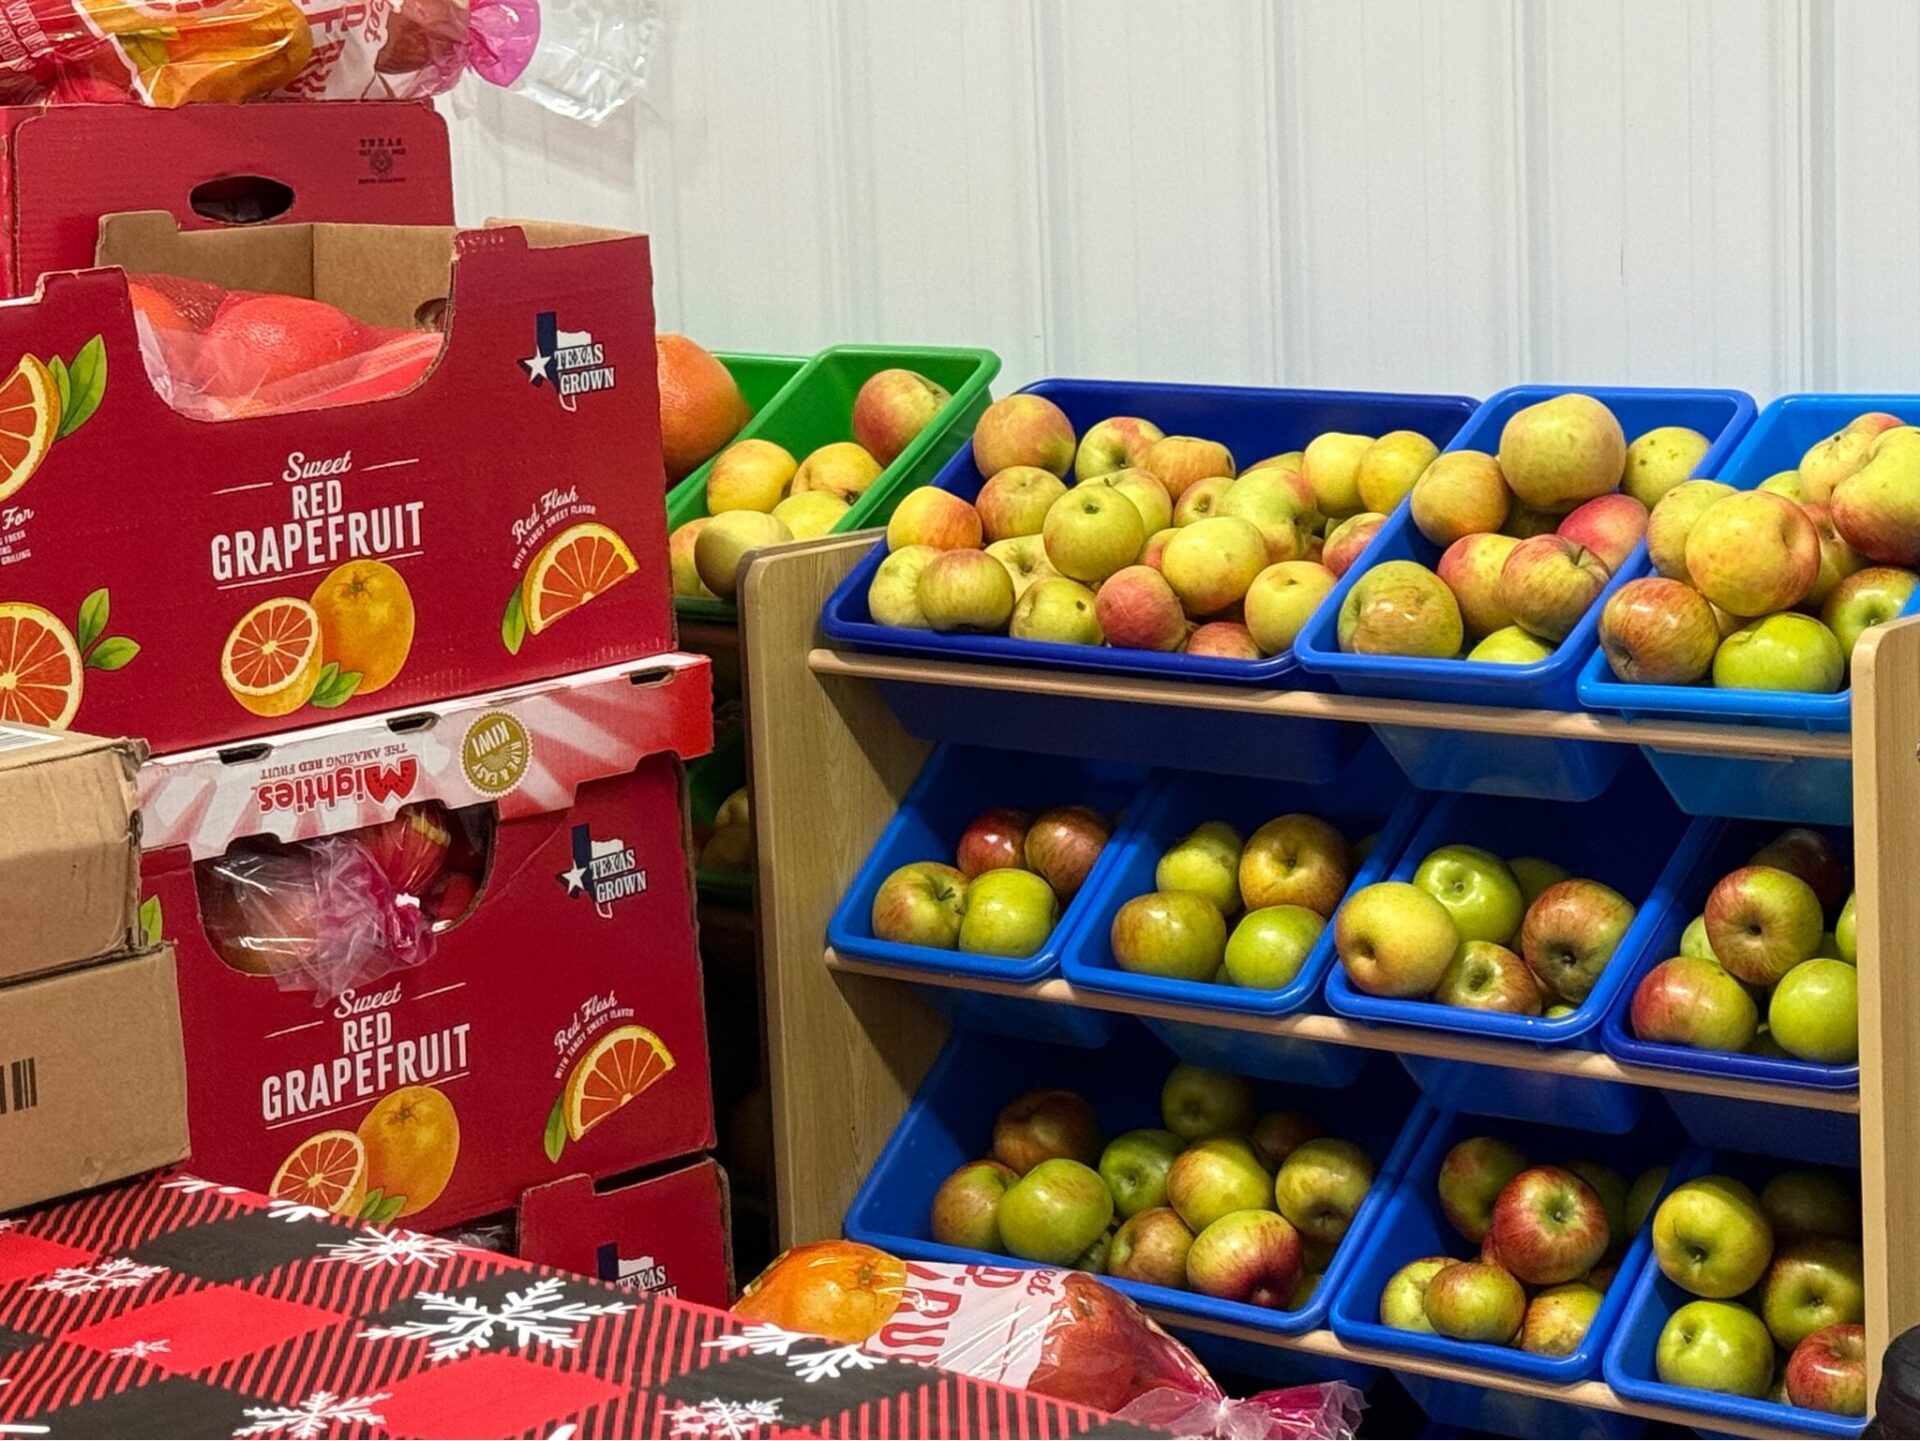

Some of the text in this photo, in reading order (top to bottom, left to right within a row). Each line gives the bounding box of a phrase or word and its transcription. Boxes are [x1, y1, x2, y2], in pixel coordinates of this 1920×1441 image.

[554, 343, 604, 370] TEXAS
[560, 367, 615, 395] GROWN
[282, 450, 352, 482] Sweet
[292, 479, 342, 520] RED
[511, 485, 579, 545] Red Flesh
[2, 506, 35, 531] For
[211, 501, 424, 581] GRAPEFRUIT
[511, 547, 528, 570] WITH
[545, 507, 569, 528] SWEET
[471, 720, 511, 758] KIWI
[260, 743, 408, 780] THE AMAZING RED FRUIT
[471, 762, 498, 786] EASY
[499, 768, 510, 782] &
[257, 756, 420, 814] Mighties
[589, 848, 636, 880] TEXAS
[595, 870, 647, 904] GROWN
[333, 982, 402, 1019] Sweet
[342, 1011, 392, 1054] RED
[554, 989, 618, 1055] Red Flesh
[586, 1012, 609, 1035] SWEET
[261, 1023, 471, 1122] GRAPEFRUIT
[1026, 1268, 1058, 1297] eet
